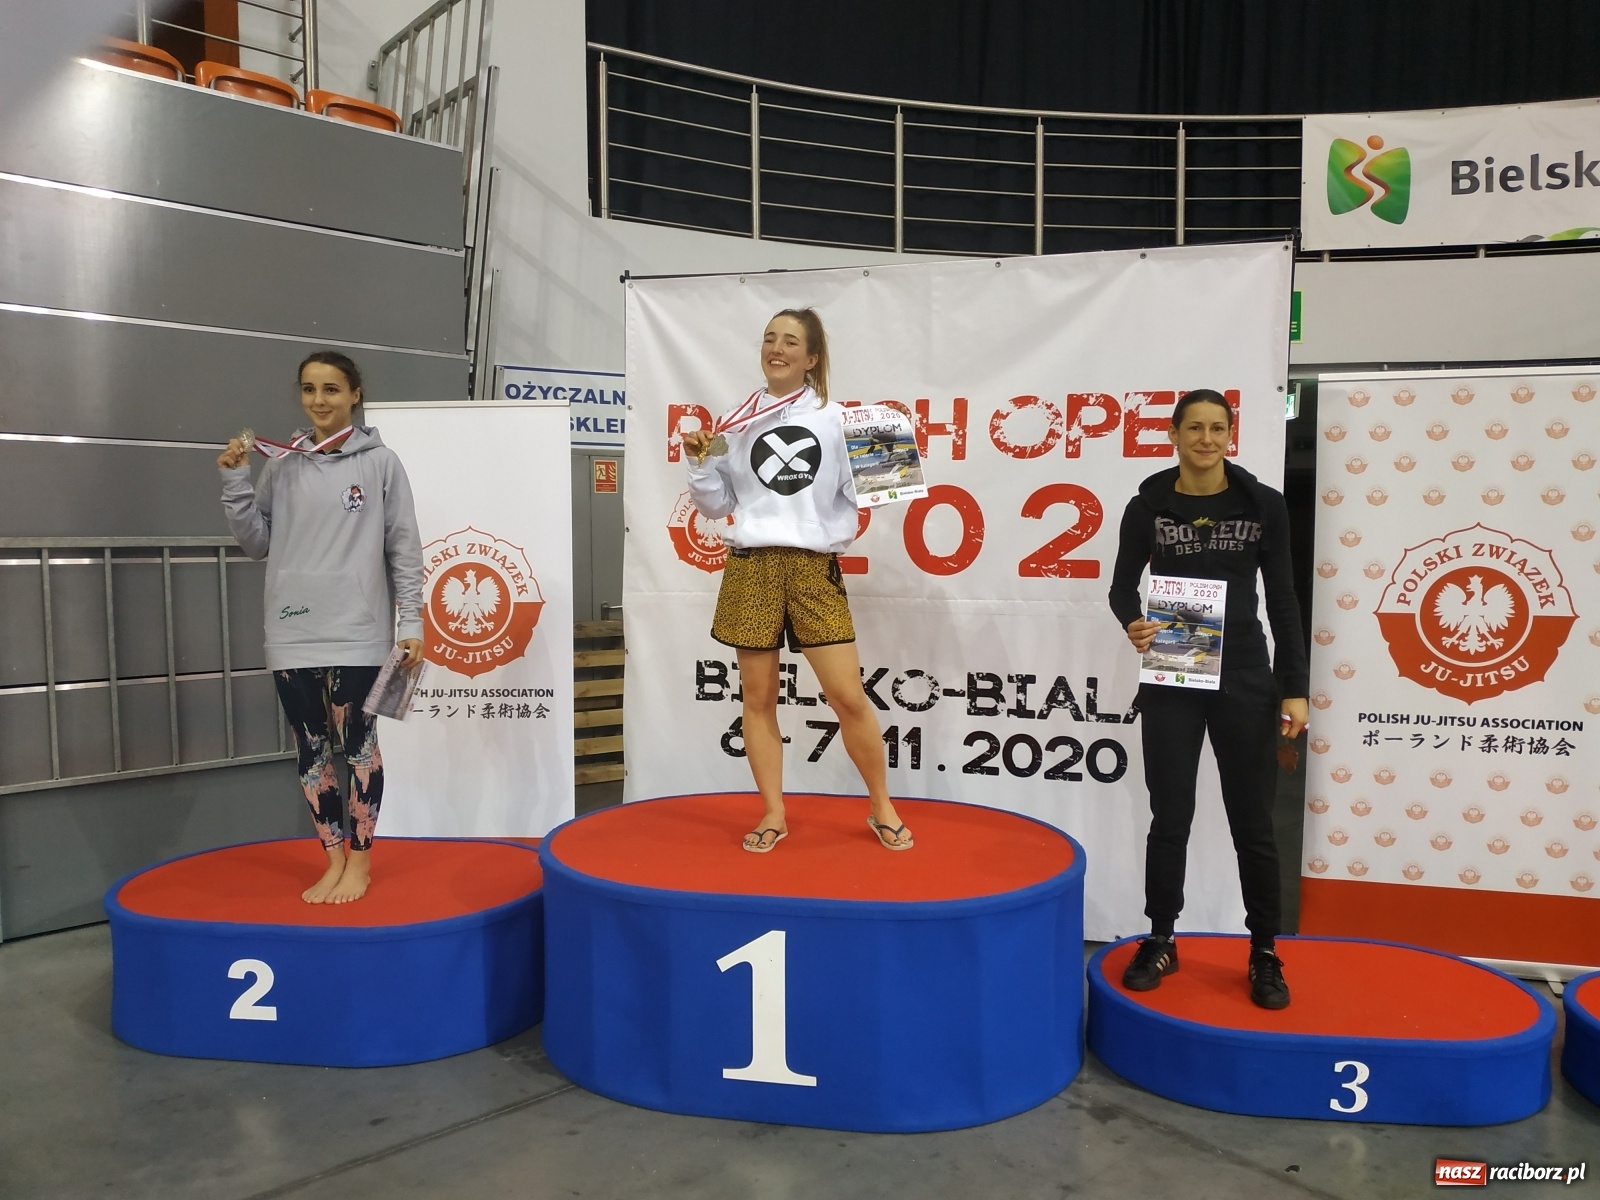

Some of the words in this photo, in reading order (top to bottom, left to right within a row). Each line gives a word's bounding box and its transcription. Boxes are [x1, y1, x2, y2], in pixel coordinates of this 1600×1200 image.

[1451, 150, 1600, 196] Bielsk
[853, 423, 902, 437] DYPLOM
[1175, 542, 1202, 556] DES
[1208, 540, 1244, 552] RUES
[467, 542, 529, 597] ZWIĄZEK
[1396, 545, 1463, 607] POLSKI
[1472, 543, 1556, 610] ZWIĄZEK
[1158, 600, 1213, 614] DYPLOM
[1194, 589, 1218, 598] 2020
[279, 605, 311, 620] Sonia
[433, 635, 514, 664] JU-JITSU
[1420, 655, 1530, 687] JU-JITSU
[430, 688, 478, 698] JU-JITSU
[481, 688, 554, 698] ASSOCIATION
[1358, 712, 1410, 724] POLISH
[1413, 714, 1477, 728] JU-JITSU
[1480, 717, 1584, 732] ASSOCIATION
[962, 730, 1128, 784] 2020
[1362, 729, 1577, 756] ポーランド柔術協会
[227, 958, 278, 1021] 2
[716, 929, 817, 1087] 1
[1330, 1060, 1370, 1113] 3
